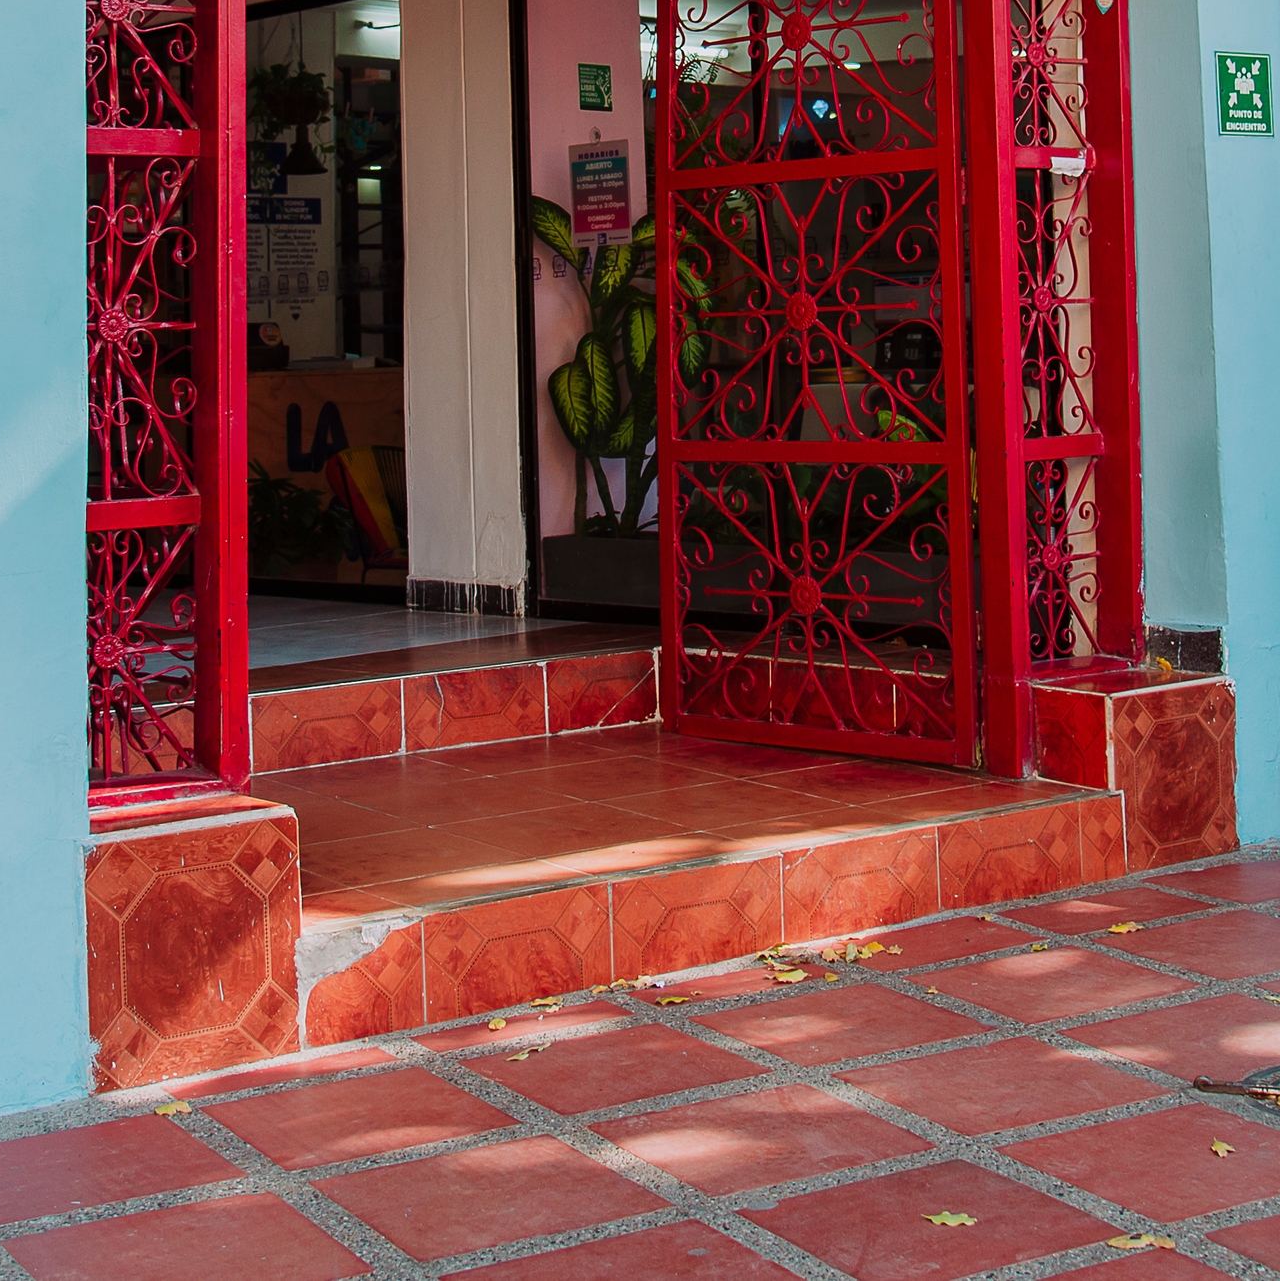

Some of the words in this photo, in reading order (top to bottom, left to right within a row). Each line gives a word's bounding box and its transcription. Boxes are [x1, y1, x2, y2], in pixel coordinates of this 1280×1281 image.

[1229, 109, 1252, 119] PUNTO
[1253, 110, 1263, 119] DE
[1226, 122, 1267, 131] ENCUENTRO
[578, 150, 620, 160] HORARIOS
[585, 161, 613, 170] ABIERTO
[600, 172, 623, 180] SABADO
[588, 194, 613, 202] FESTIVOS
[587, 214, 615, 222] DOMINGO
[286, 400, 349, 474] LA
